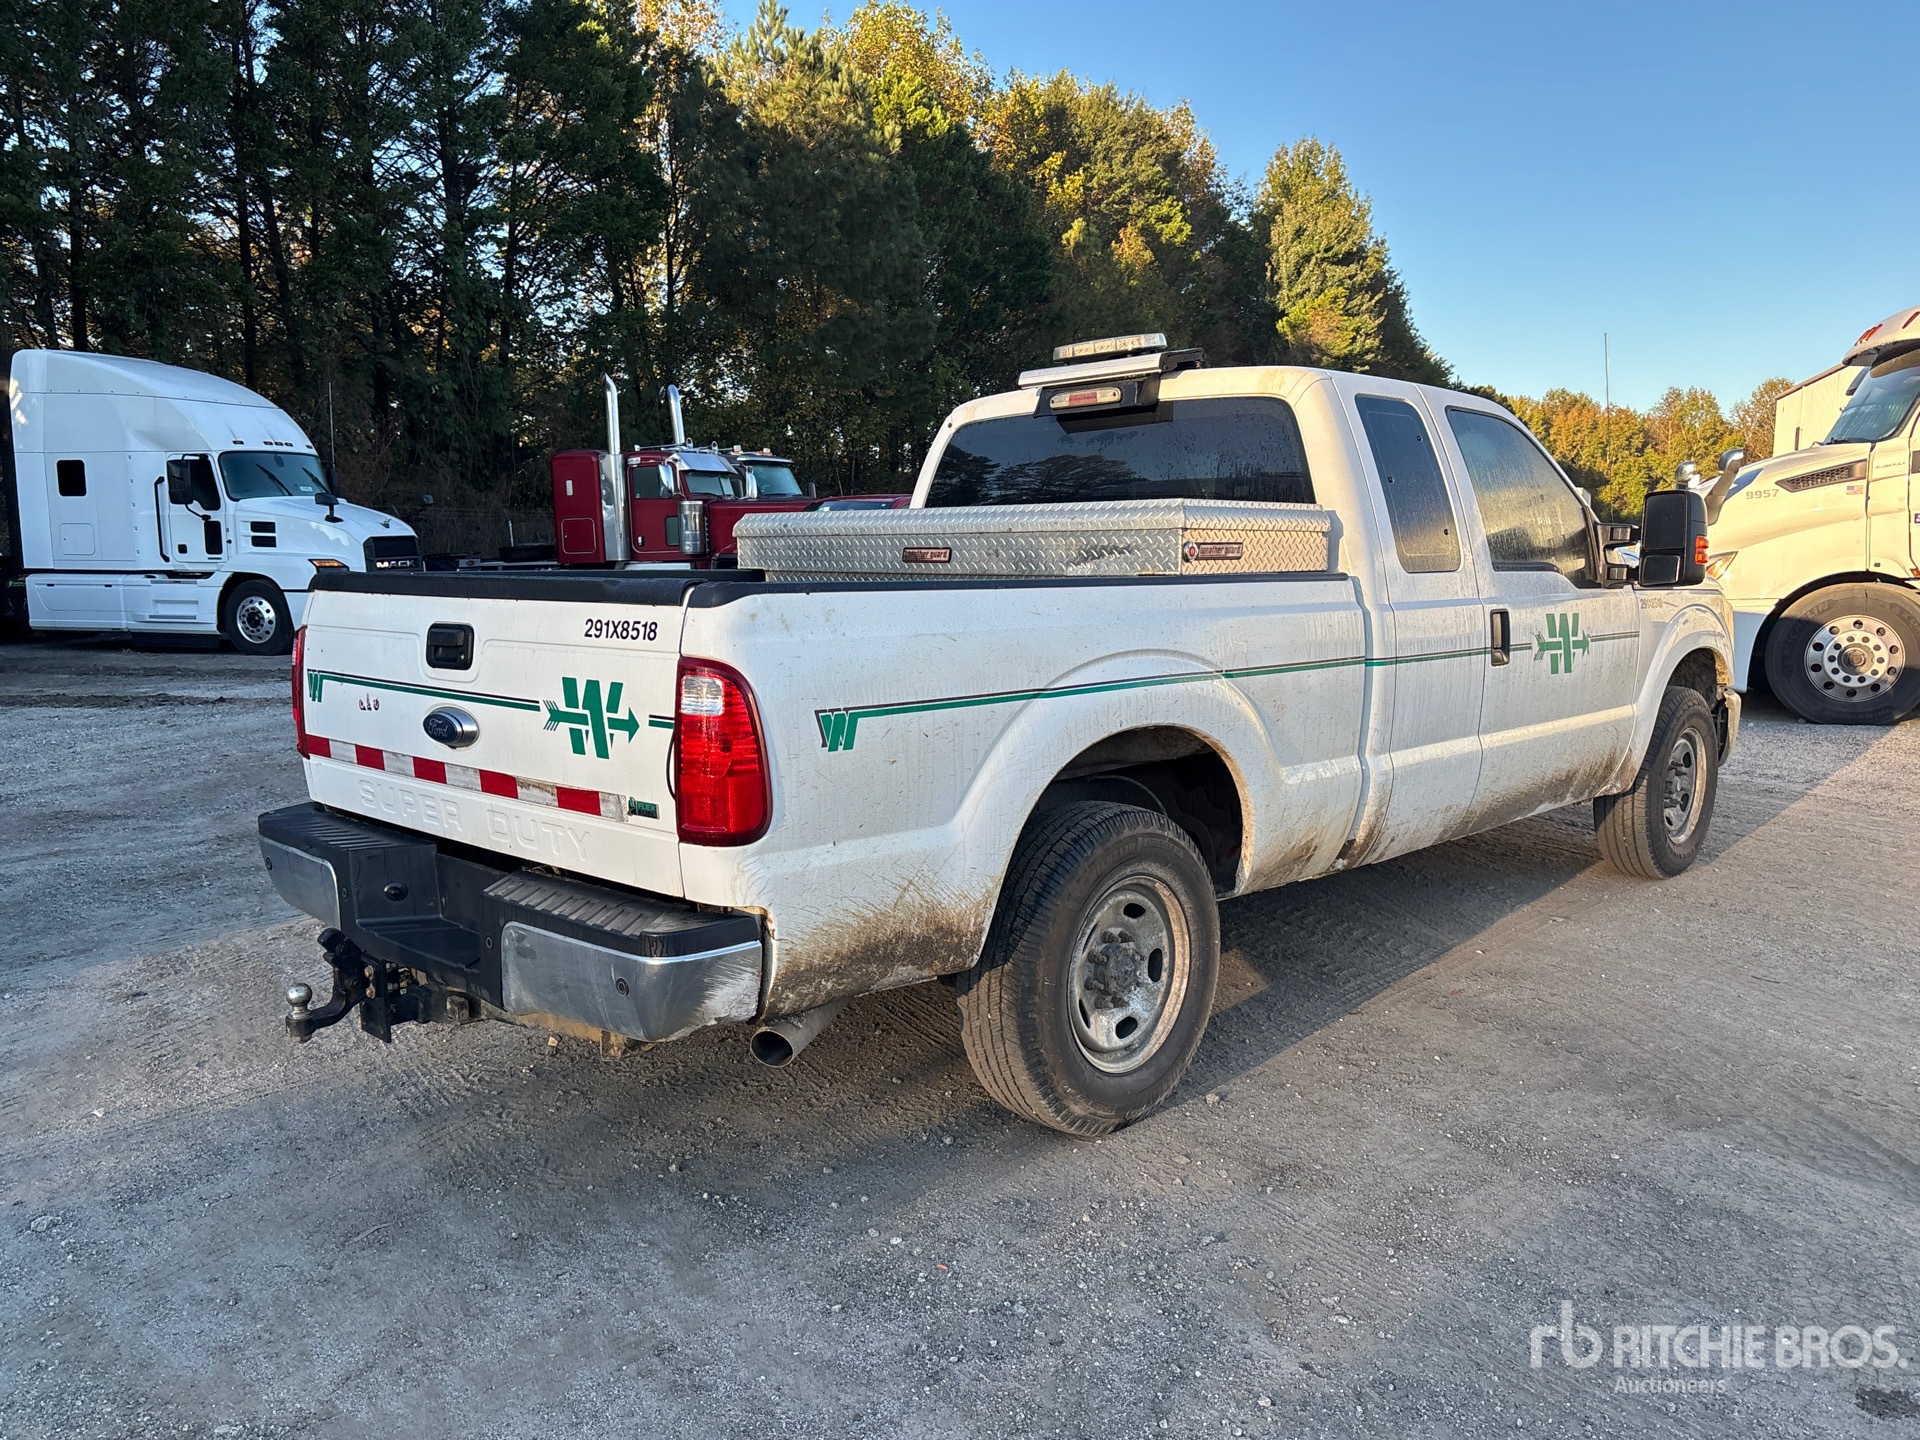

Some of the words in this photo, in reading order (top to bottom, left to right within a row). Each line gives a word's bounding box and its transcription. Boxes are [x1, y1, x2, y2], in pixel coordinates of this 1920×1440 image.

[1746, 489, 1779, 500] 9957
[376, 560, 416, 568] MACK
[584, 618, 658, 641] 291X8518
[428, 717, 449, 738] Ford
[637, 802, 657, 812] FLEX
[359, 779, 464, 832] SUPER
[486, 808, 592, 862] DUTY
